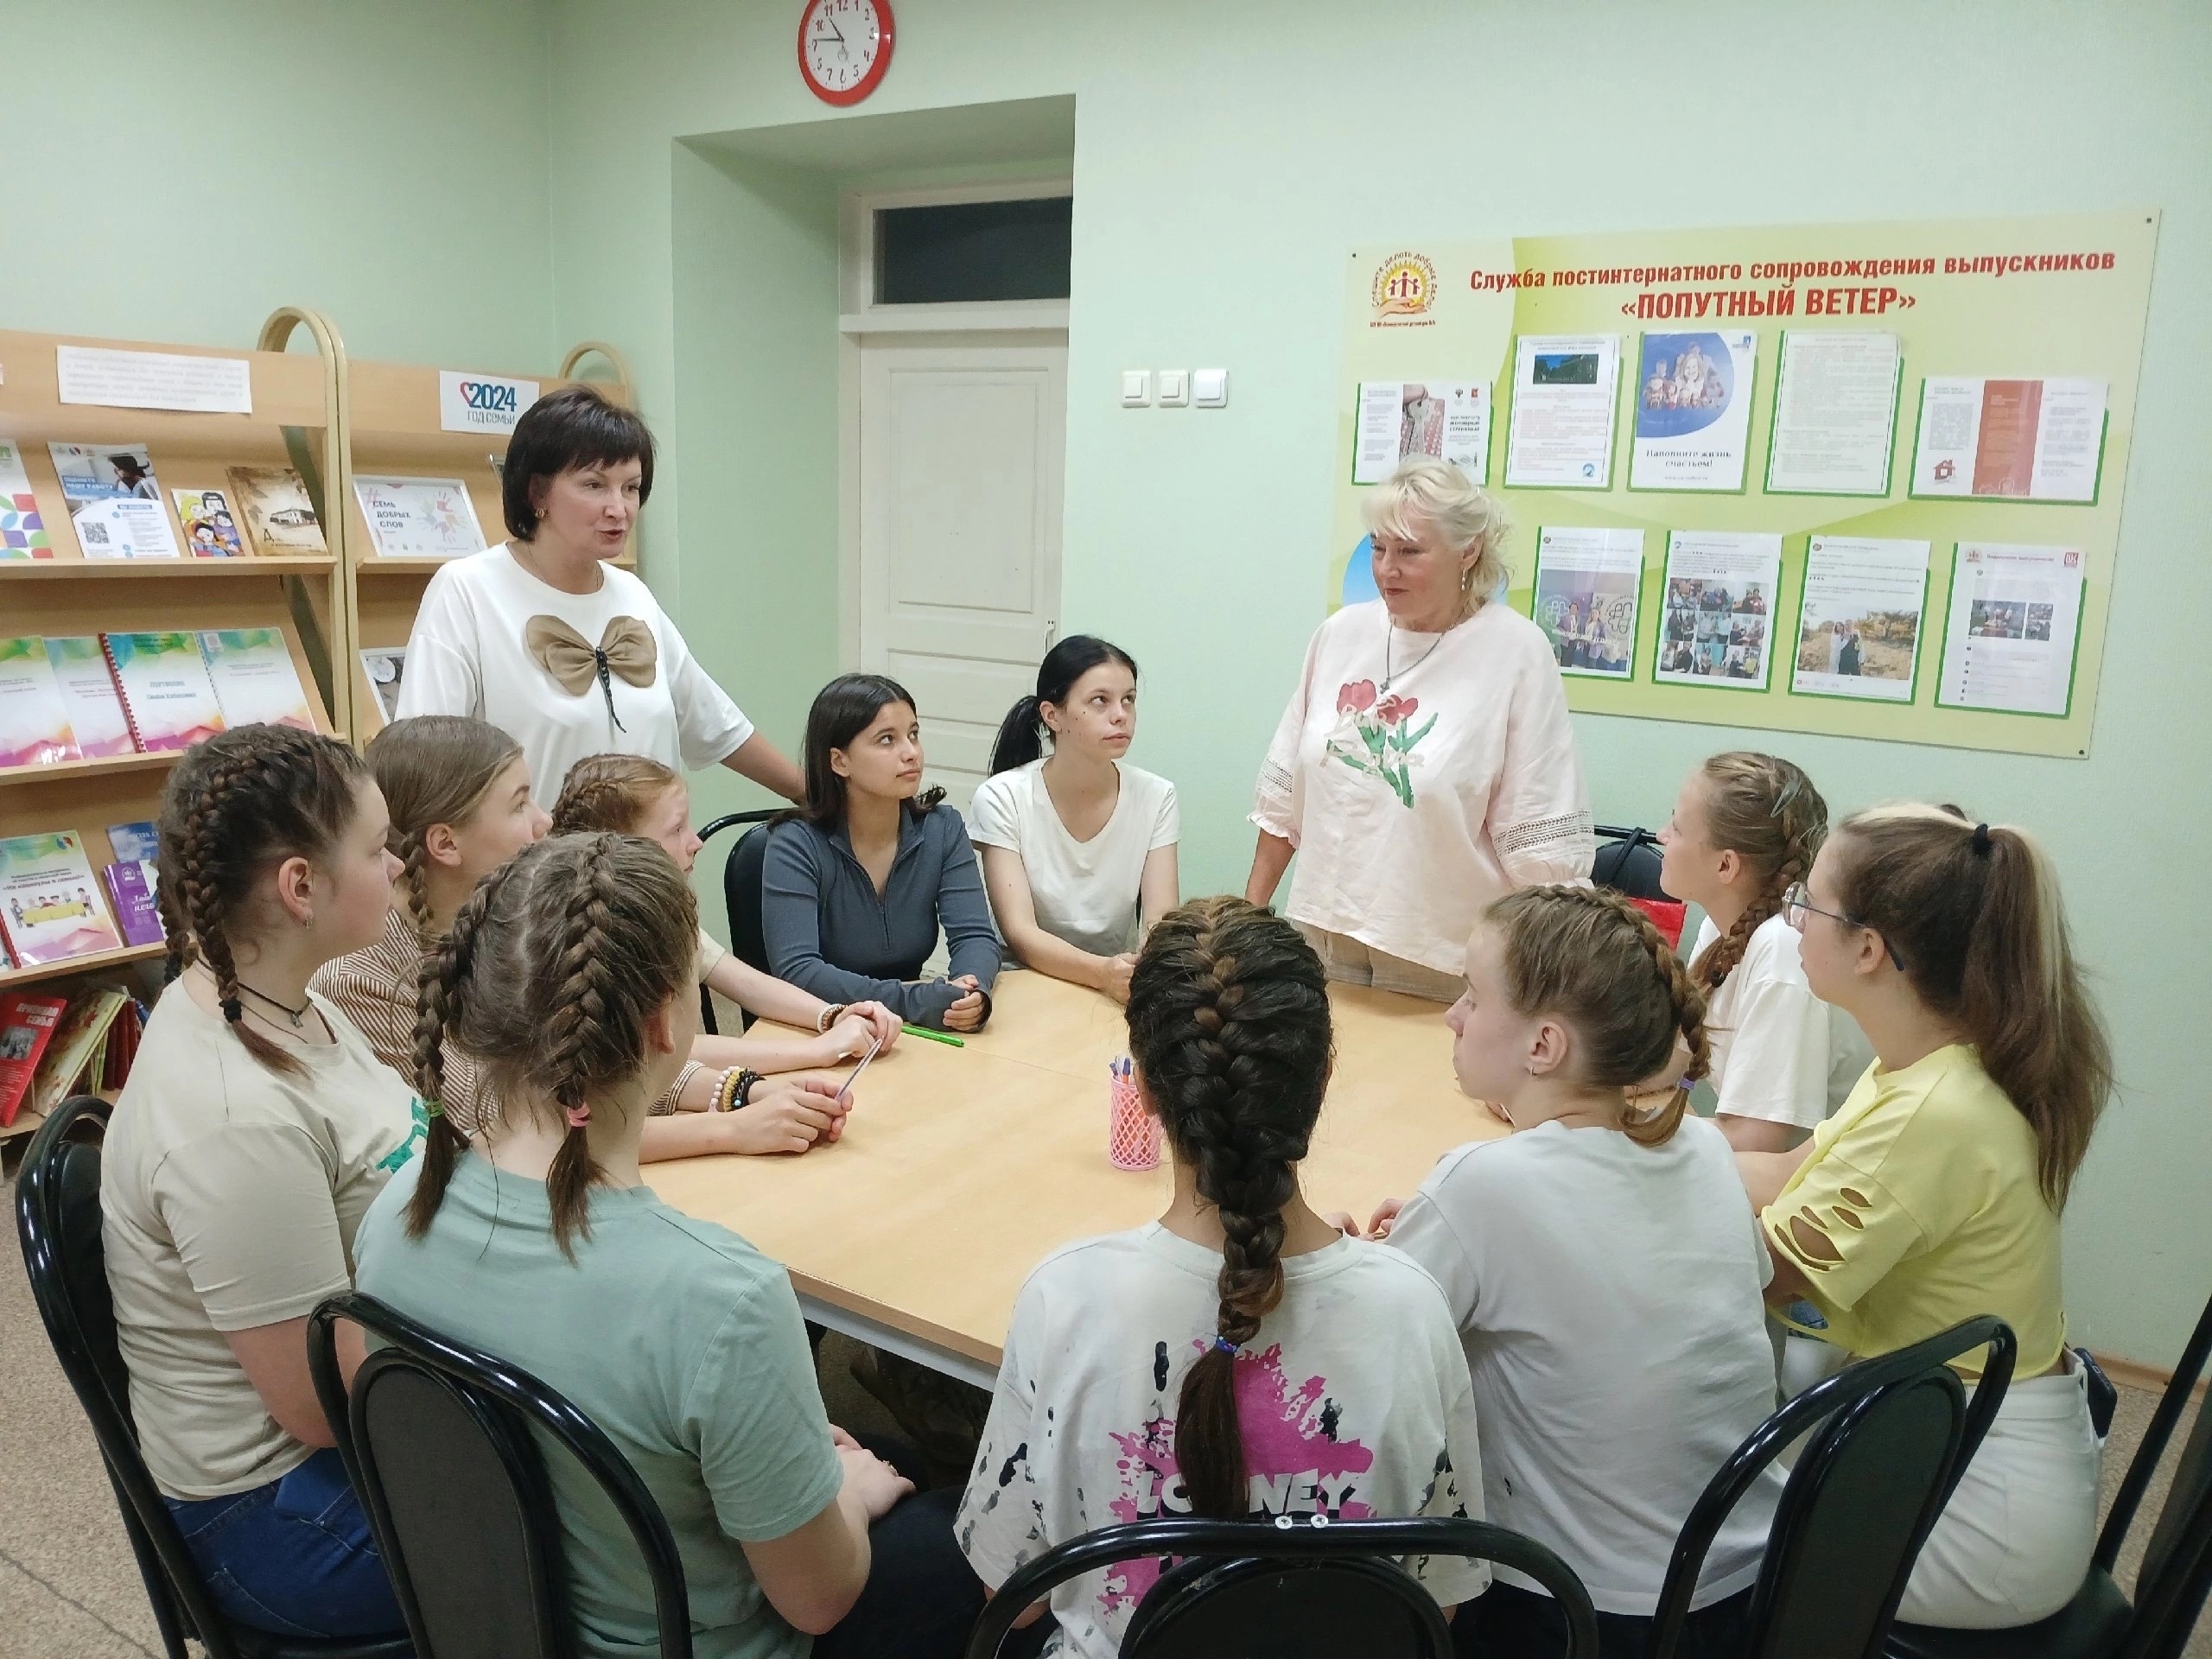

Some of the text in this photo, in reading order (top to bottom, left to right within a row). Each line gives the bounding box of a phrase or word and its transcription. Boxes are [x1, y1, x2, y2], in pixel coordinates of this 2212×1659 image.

[824, 3, 833, 16] 11
[816, 19, 824, 32] 10
[1471, 251, 2115, 293] Служба постинтернатного сопровождения выпускников
[1621, 283, 1916, 319] «ПОПУТНЫЙ ВЕТЕР»
[467, 383, 517, 412] 2024
[467, 410, 484, 424] ГОД
[1136, 1468, 1357, 1517] LONEY
